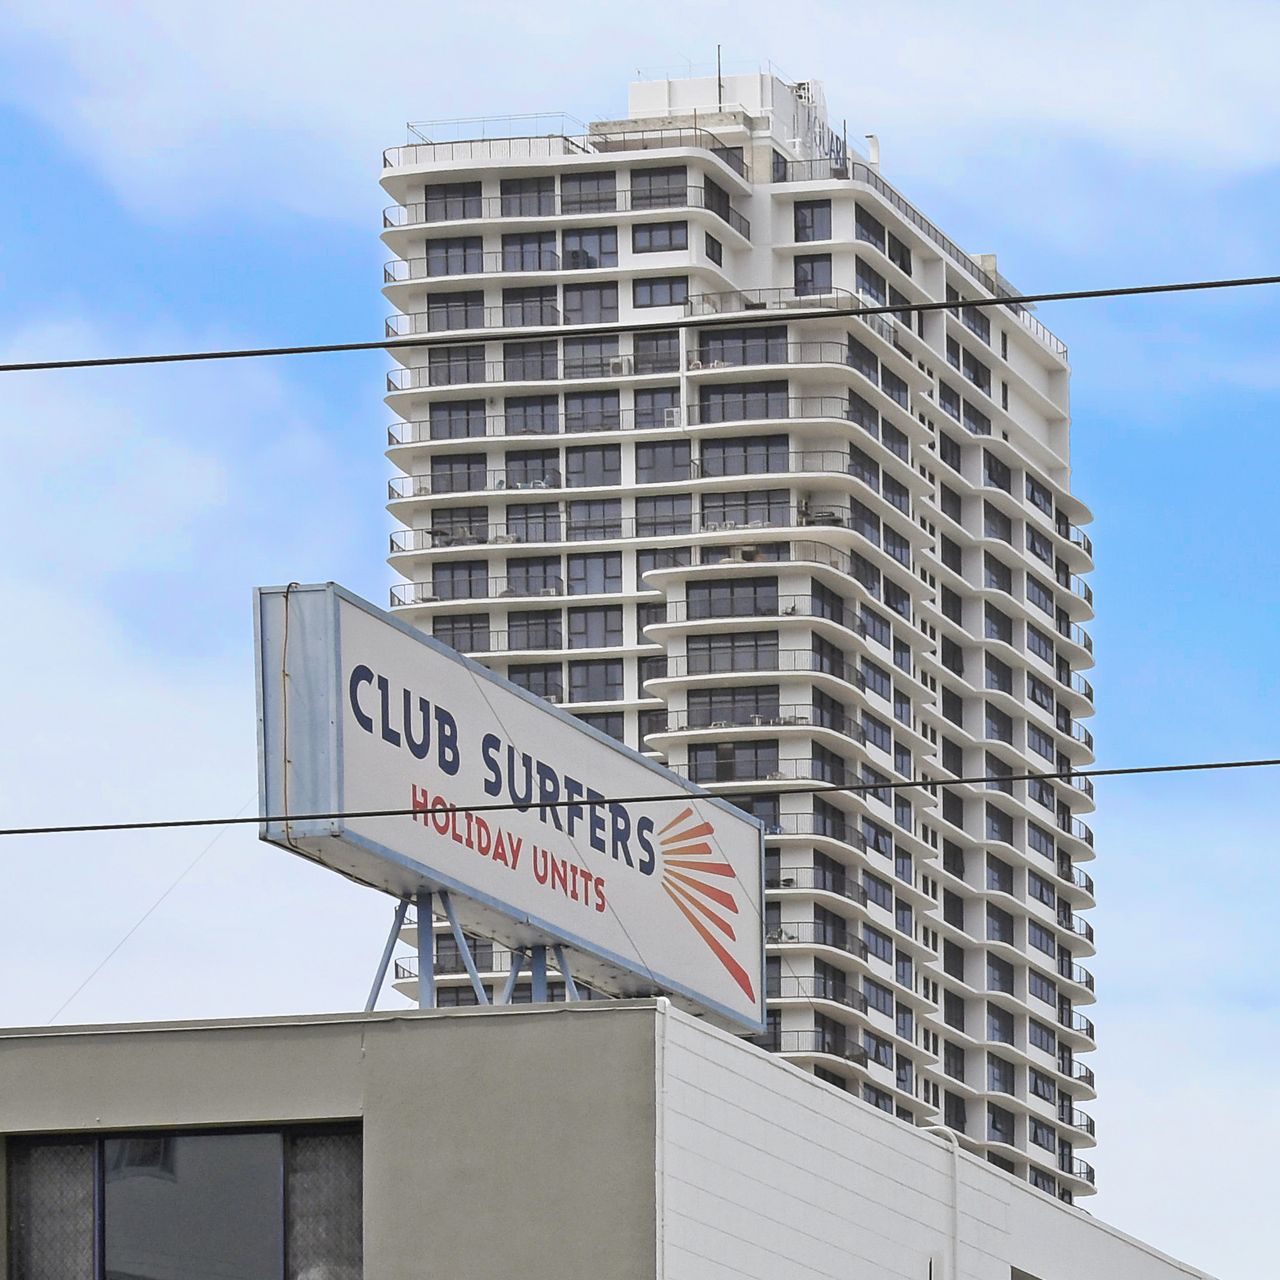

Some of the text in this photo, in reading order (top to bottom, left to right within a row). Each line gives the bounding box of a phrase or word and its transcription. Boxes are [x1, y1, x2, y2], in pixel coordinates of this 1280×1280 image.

[349, 664, 656, 876] CLUB SURFERS
[411, 783, 606, 913] HOLIDAY UNITS
